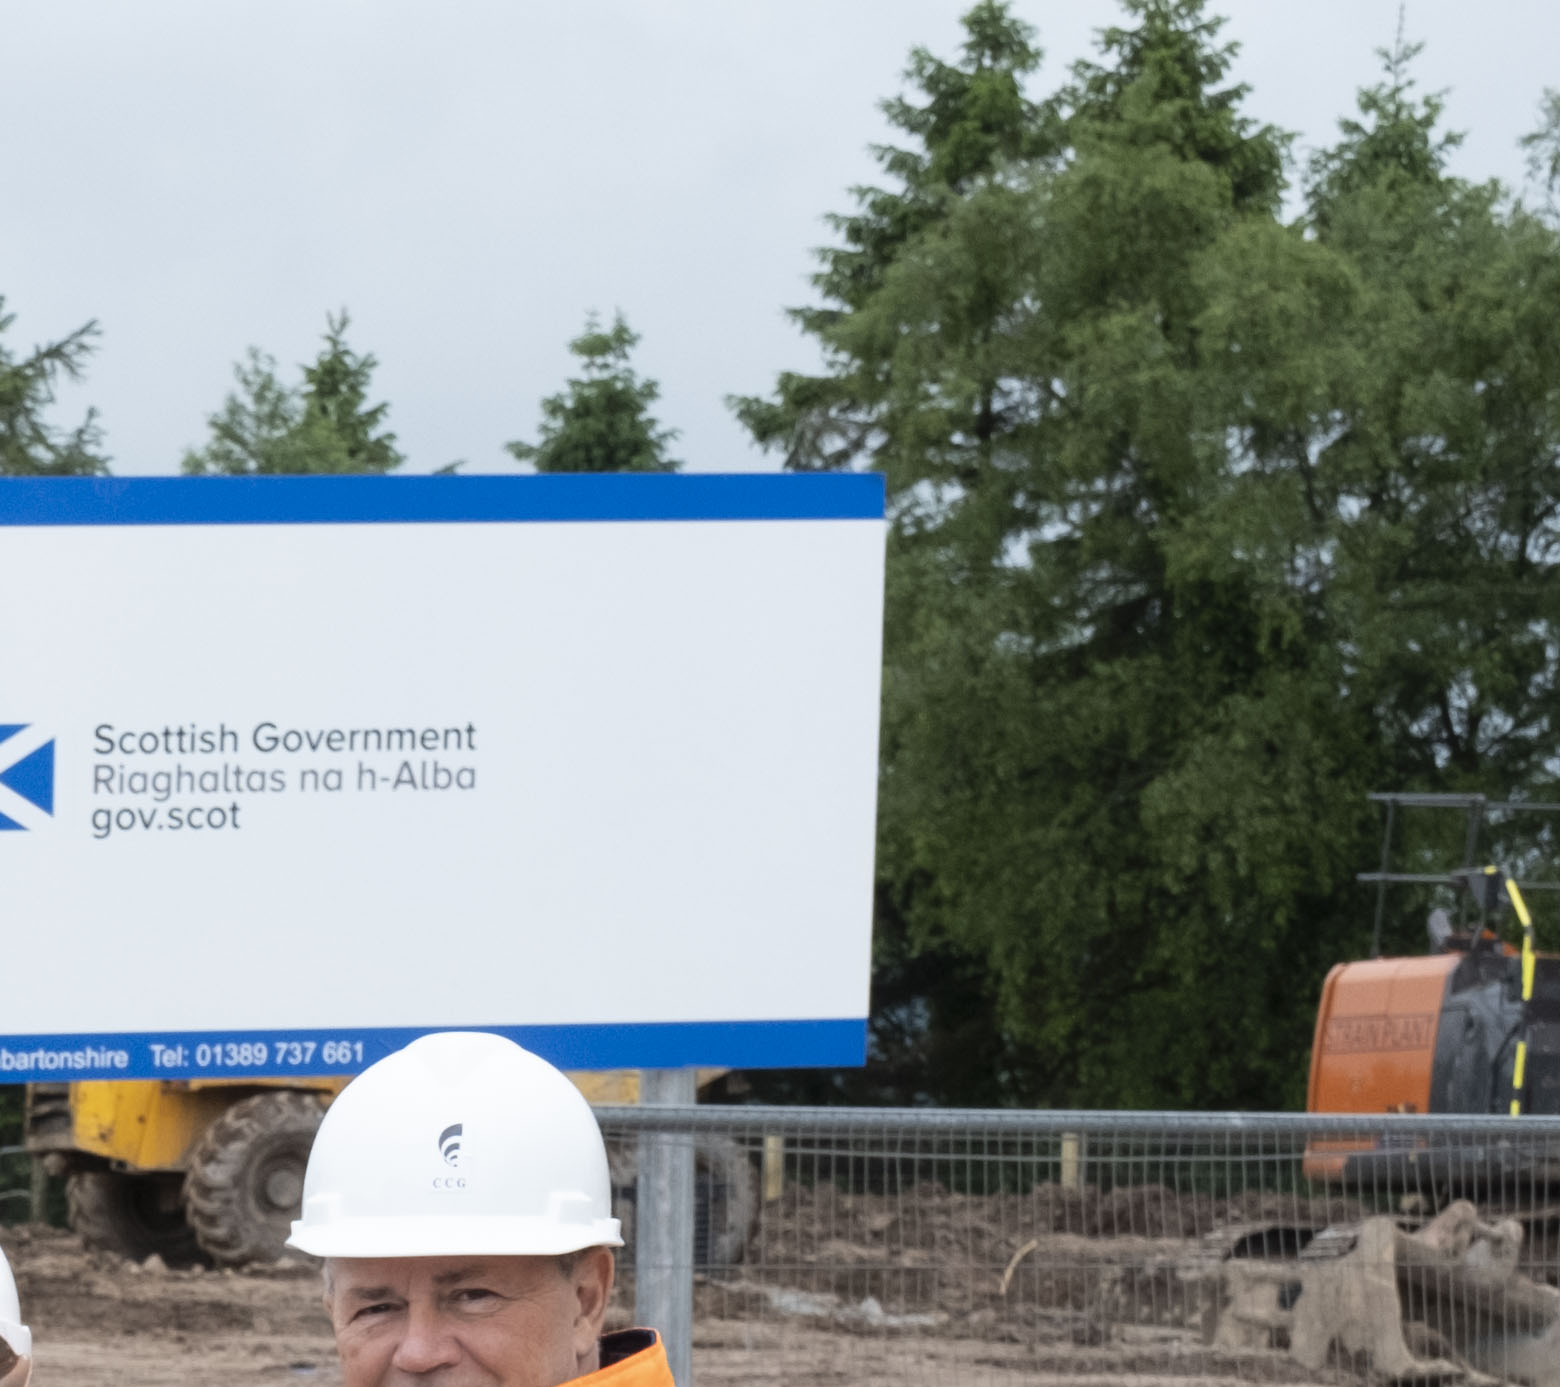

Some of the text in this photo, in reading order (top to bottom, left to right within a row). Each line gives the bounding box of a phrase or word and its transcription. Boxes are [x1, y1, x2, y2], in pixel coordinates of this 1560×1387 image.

[94, 721, 477, 756] Scottish Government
[93, 759, 476, 799] Riaghaltas na h-Alba
[91, 801, 241, 839] gov.scot
[149, 1043, 189, 1068] Tel:
[196, 1041, 269, 1067] 01389
[274, 1040, 318, 1066] 737
[322, 1039, 365, 1065] 661
[432, 1176, 466, 1189] CCG
